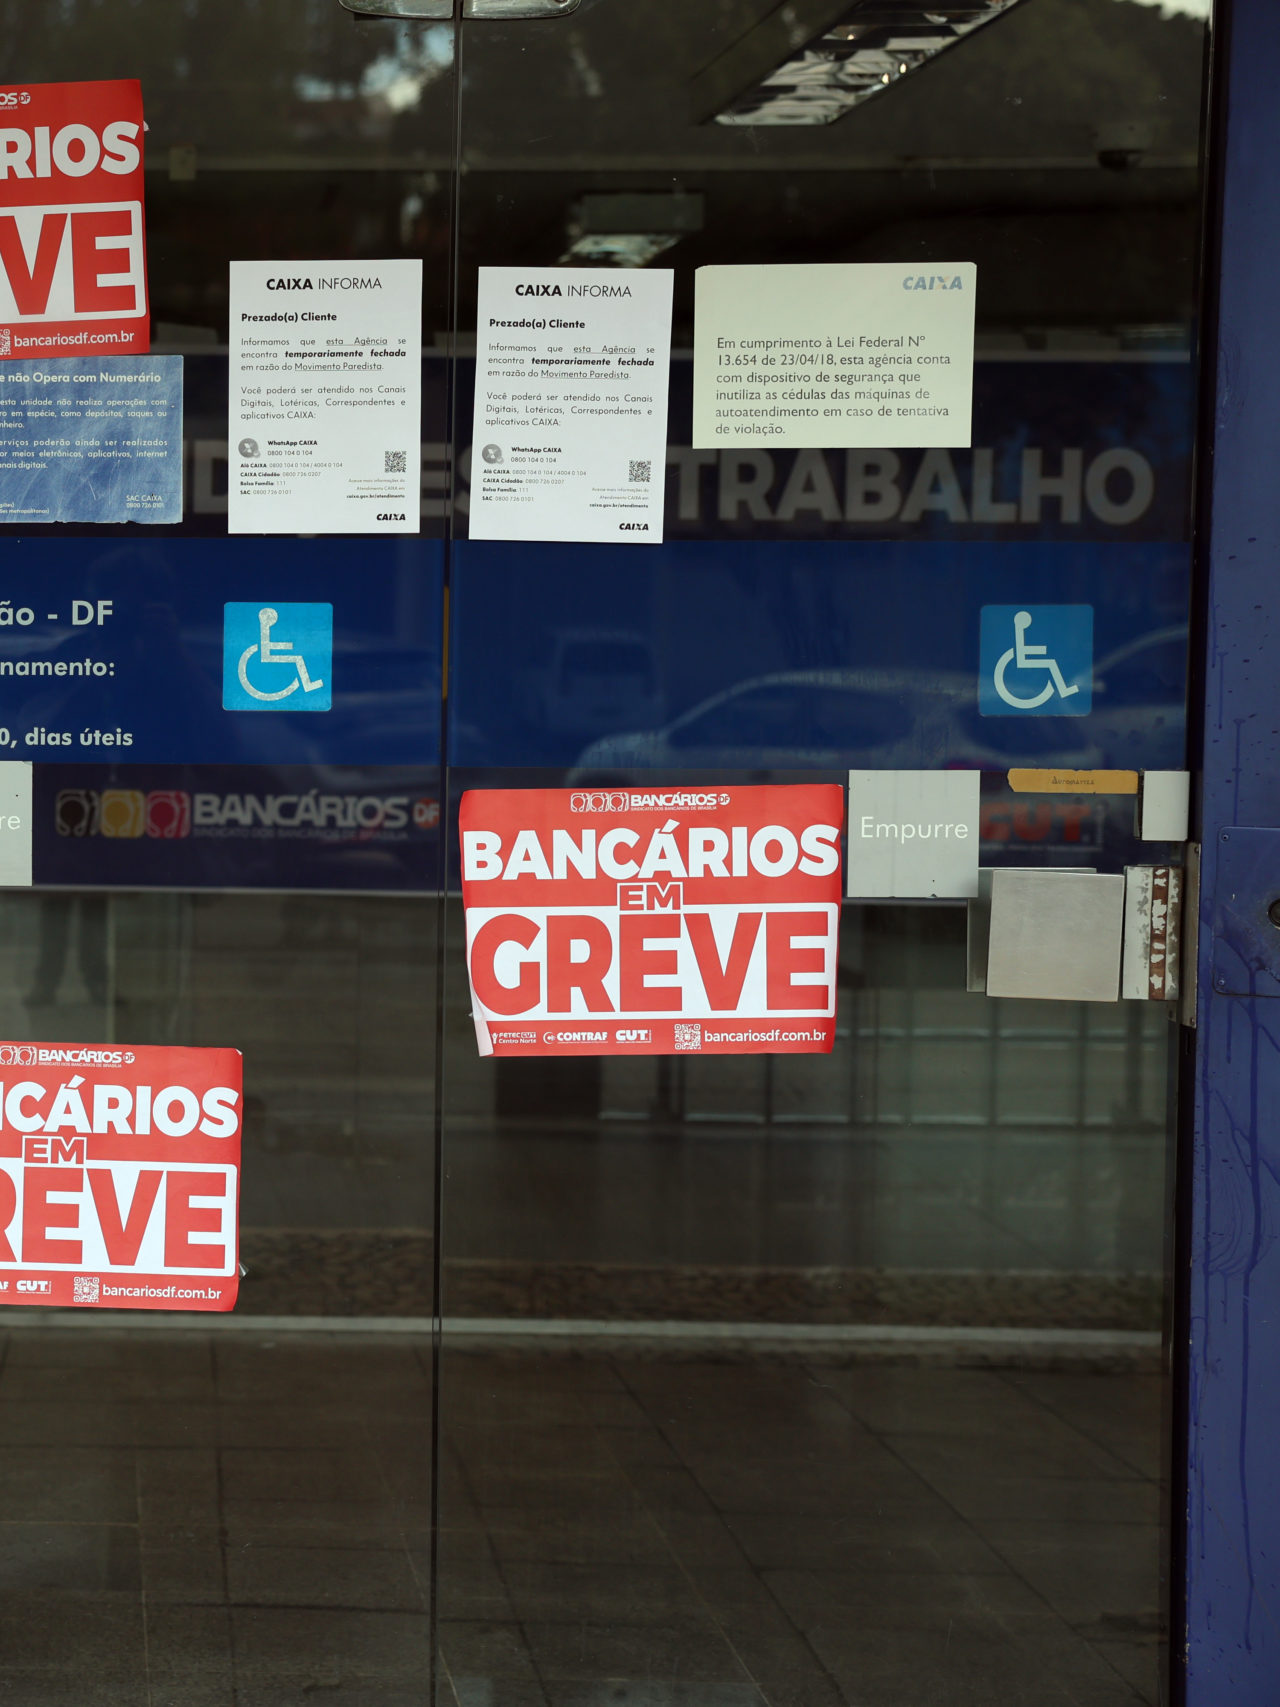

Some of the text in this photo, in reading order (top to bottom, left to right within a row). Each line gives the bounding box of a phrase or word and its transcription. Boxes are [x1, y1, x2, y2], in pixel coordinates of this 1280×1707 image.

[266, 277, 382, 291] CAIXA INFORMA
[901, 275, 964, 291] CAIXA
[515, 284, 632, 298] CAIXA INFORMA
[241, 312, 337, 323] Prezado(a) Cliente
[489, 318, 586, 330] Prezado(a) Cliente
[14, 331, 134, 347] bancariosdf.com.br
[241, 337, 290, 346] Informamos
[299, 339, 316, 347] que
[326, 338, 344, 346] esta
[353, 336, 388, 347] Agência
[717, 335, 926, 350] Em cumprimento à Lei Federal Nº
[285, 349, 364, 359] temporariamente
[370, 349, 407, 357] fechada
[718, 353, 951, 367] 13.654 de 23/04/18, esta agência conta
[256, 362, 280, 371] razão
[282, 362, 293, 371] do
[295, 363, 341, 371] Movimento
[343, 362, 384, 371] Paredista.
[8, 372, 30, 383] não
[33, 372, 70, 385] Opera
[73, 375, 97, 383] com
[100, 372, 161, 383] Numerário
[716, 371, 921, 385] com dispositivo de segurança que
[716, 388, 930, 402] inutiliza as cédulas das máquinas de
[669, 449, 1155, 526] TRABALHO
[376, 513, 406, 521] CAIXA
[619, 522, 649, 531] CAIXA
[72, 600, 113, 626] DF
[25, 727, 72, 746] dias
[80, 728, 133, 746] úteis
[631, 792, 716, 806] BANCÁRIOS
[194, 788, 408, 828] BANCÁRIOS
[861, 816, 969, 844] Empurre
[463, 818, 839, 881] BANCÁRIOS
[619, 883, 681, 911] EM
[471, 911, 829, 1015] GREVE
[557, 1032, 608, 1041] CONTRAF
[616, 1030, 648, 1041] CUT
[705, 1029, 826, 1043] bancariosdf.com.br
[38, 1048, 122, 1063] BANCÁRIOS
[24, 1137, 85, 1164] EM
[16, 1280, 49, 1293] CUT
[103, 1285, 221, 1300] bancariosdf.com.br
